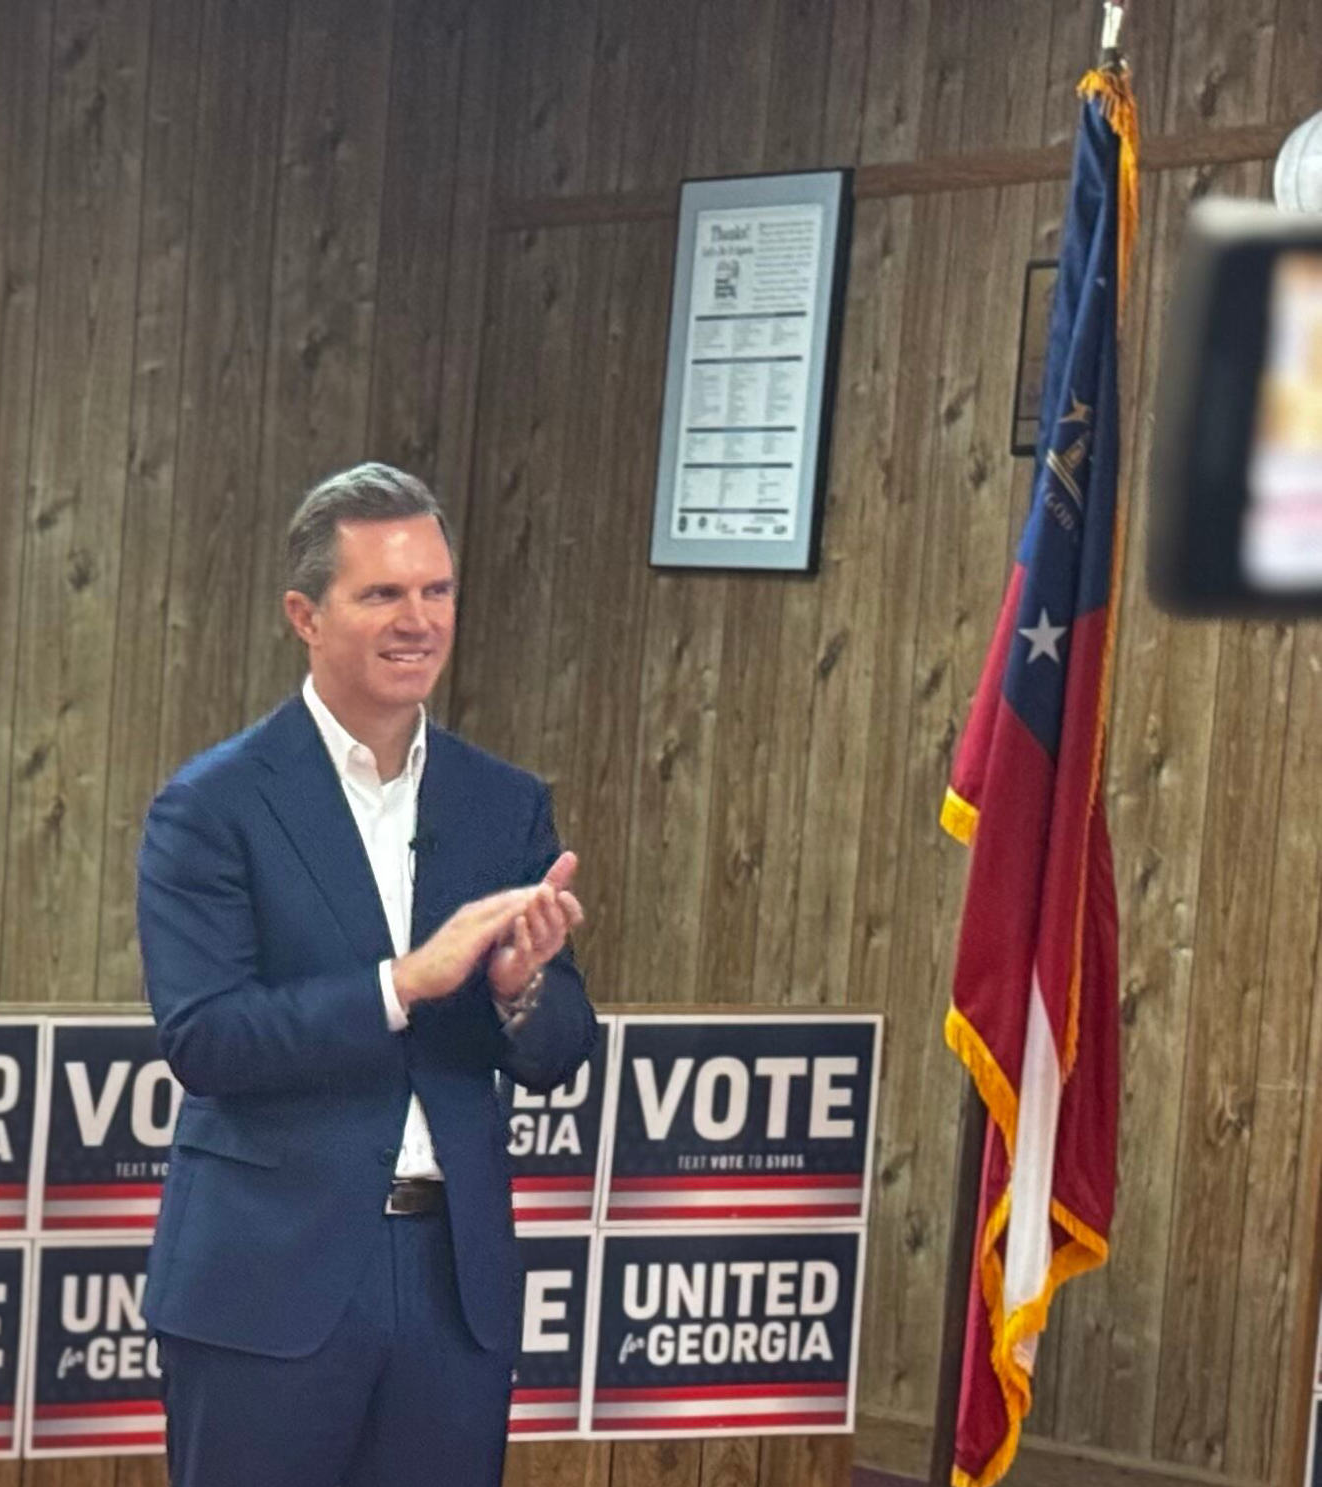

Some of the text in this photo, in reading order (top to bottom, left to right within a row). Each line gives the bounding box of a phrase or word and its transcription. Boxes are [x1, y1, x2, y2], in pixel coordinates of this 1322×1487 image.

[64, 1059, 186, 1147] VO
[632, 1056, 859, 1142] VOTE
[151, 1162, 169, 1177] VO
[710, 1154, 743, 1170] VOTE
[622, 1259, 840, 1321] UNITED
[618, 1320, 834, 1367] for GEORGIA
